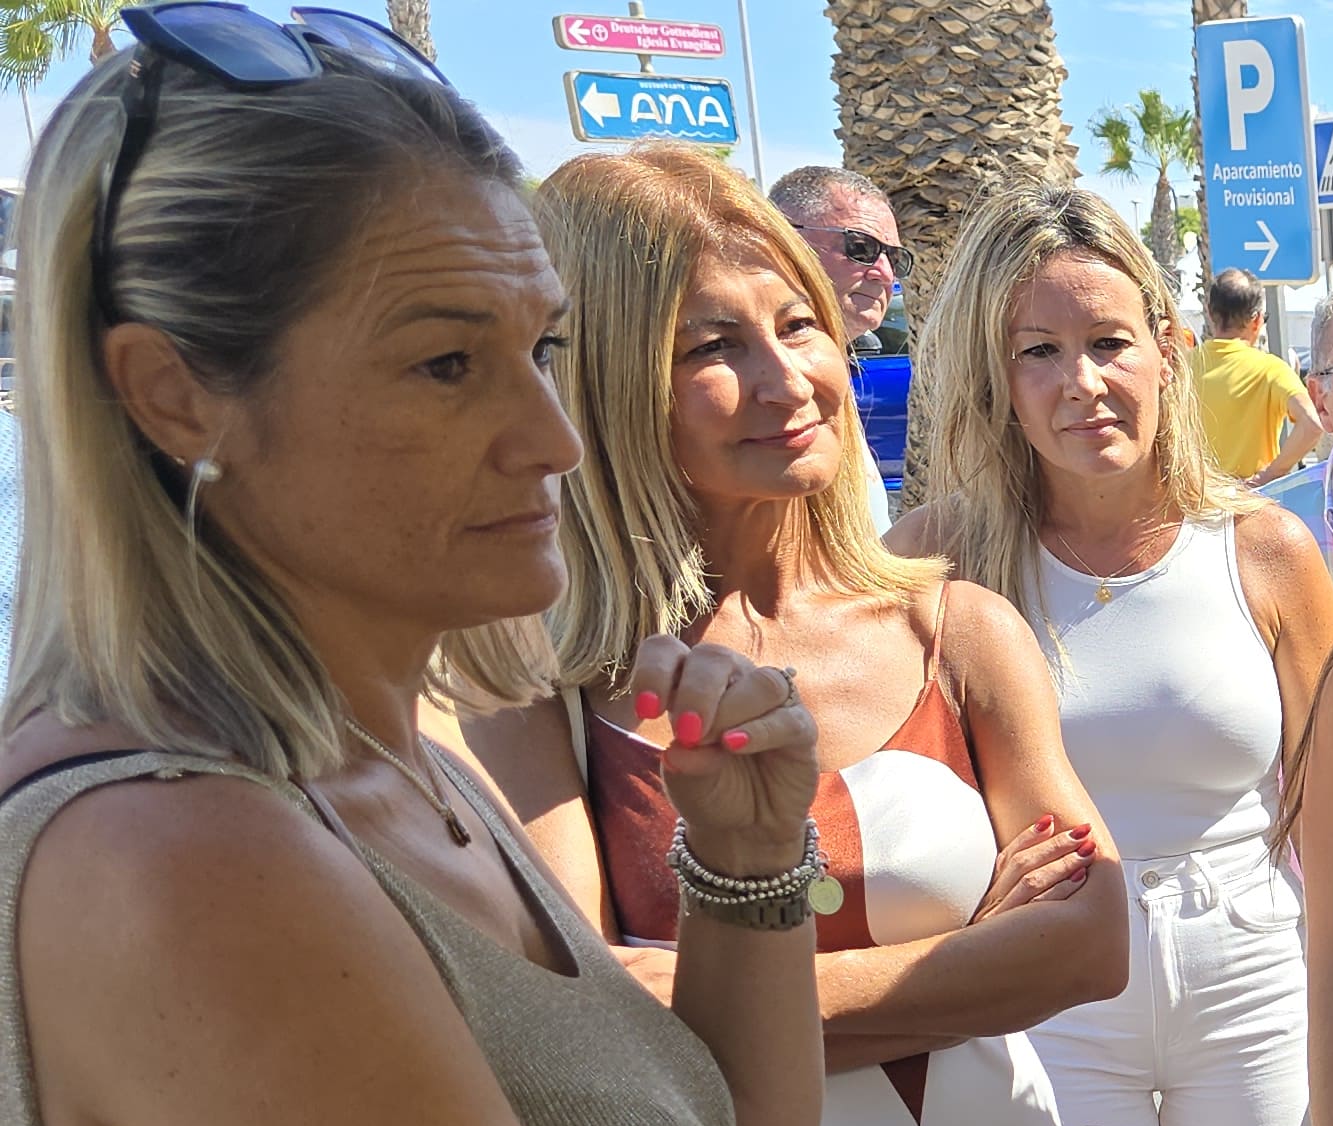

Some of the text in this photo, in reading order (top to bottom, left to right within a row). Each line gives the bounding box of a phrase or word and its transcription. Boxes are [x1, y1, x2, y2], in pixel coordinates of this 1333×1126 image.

[611, 22, 720, 41] Deutscher Gottesdienst
[637, 36, 722, 53] Iglesia Evangélica
[1223, 39, 1275, 151] P
[1212, 160, 1303, 186] Aparcamiento
[1223, 187, 1296, 208] Provisional
